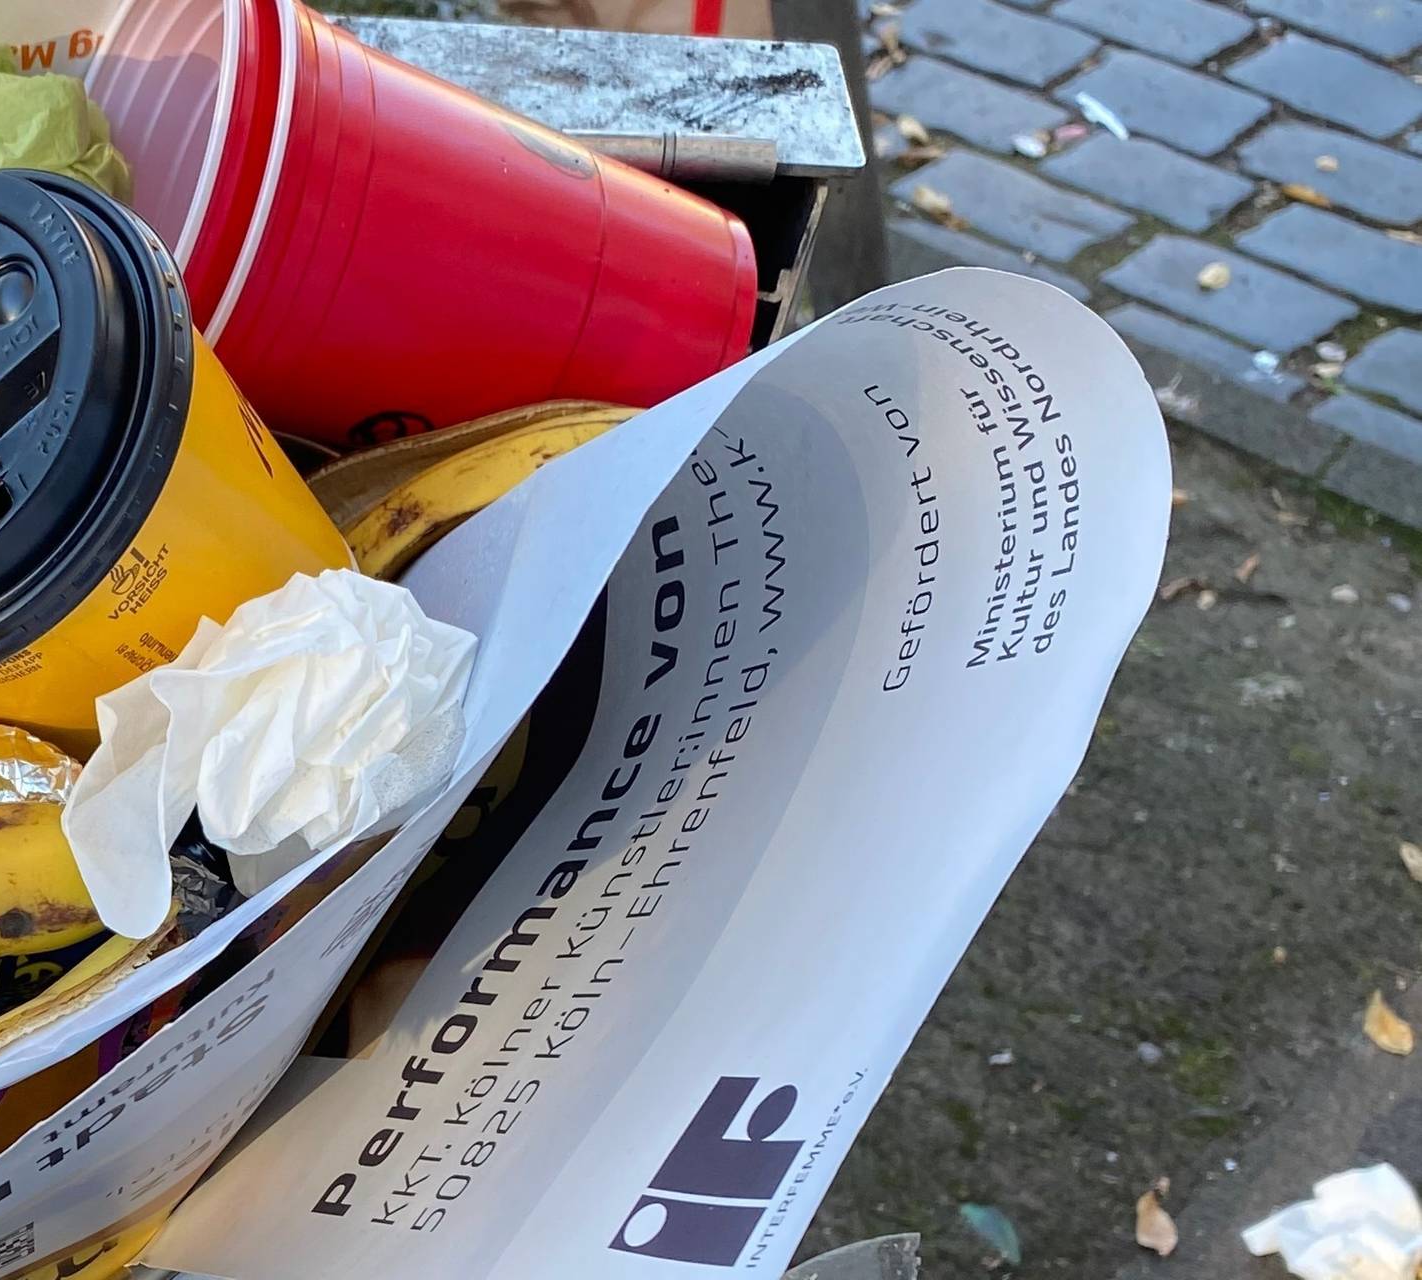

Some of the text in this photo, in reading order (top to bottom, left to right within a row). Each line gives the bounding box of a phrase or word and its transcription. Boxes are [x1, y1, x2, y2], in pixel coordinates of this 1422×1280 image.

[0, 318, 45, 359] HOT
[108, 543, 170, 620] VORSICHT
[130, 567, 168, 614] HEISS
[862, 384, 939, 692] Gefördert von
[959, 387, 1014, 668] Ministerium für
[996, 549, 1046, 661] Kultur
[1022, 459, 1050, 537] und
[1031, 590, 1068, 656] des
[1051, 432, 1081, 576] Landes
[23, 651, 43, 666] APP
[311, 712, 661, 1217] Performance
[644, 515, 686, 690] von
[370, 1143, 452, 1227] KKT.
[445, 979, 560, 1125] Kölner
[691, 449, 740, 566] The
[410, 1079, 542, 1233] 50825
[534, 646, 780, 1059] Köln-Ehrenfeld,
[33, 997, 278, 1174] Stadt
[38, 968, 278, 1145] Kulturamt
